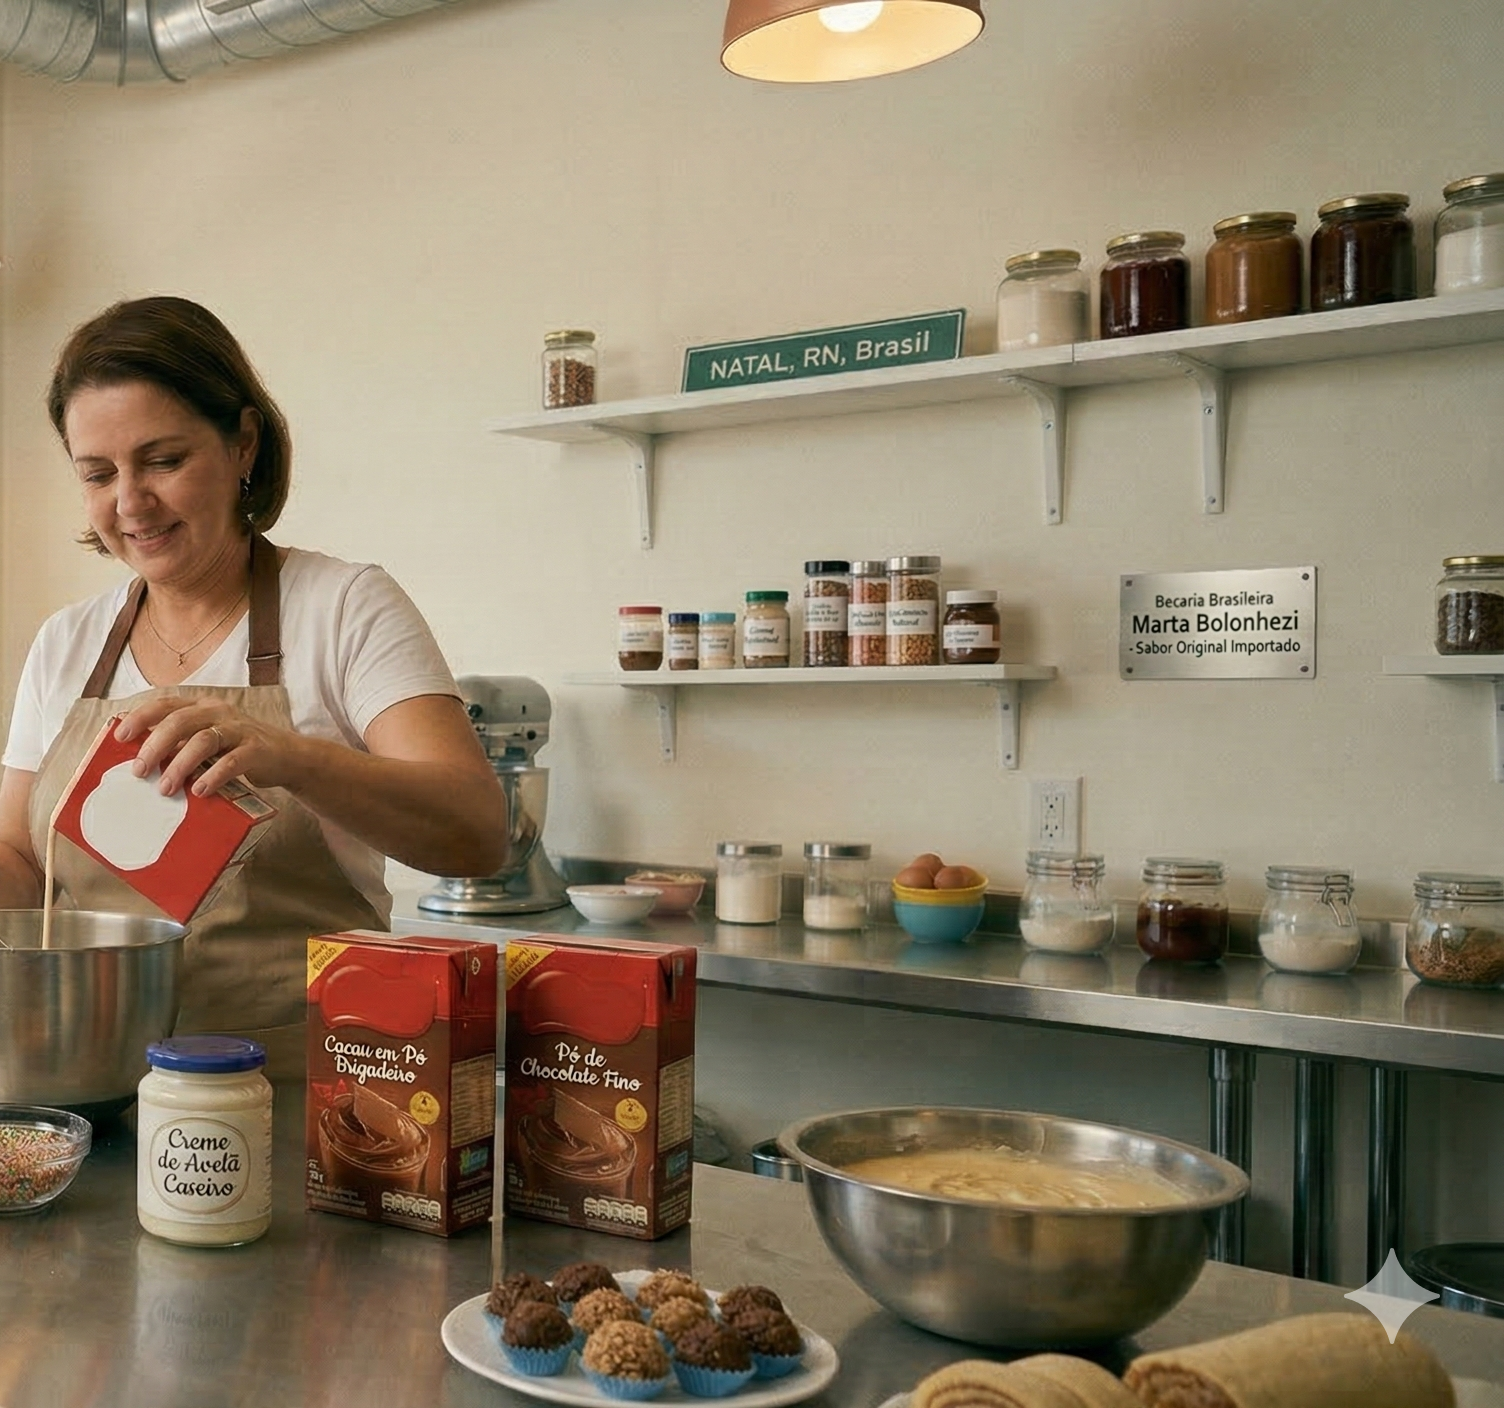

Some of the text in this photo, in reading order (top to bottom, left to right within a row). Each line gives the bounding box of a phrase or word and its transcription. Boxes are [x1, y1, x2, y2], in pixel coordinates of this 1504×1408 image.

[709, 330, 930, 381] NATAL, RN, Brasil
[1155, 591, 1274, 608] Becaria Brasileira
[1132, 610, 1299, 634] Marta Bolonhezi
[1136, 640, 1173, 655] Sabor
[1176, 639, 1227, 658] Original
[1231, 638, 1301, 656] Importado
[324, 1034, 428, 1066] Cacau em Pó
[554, 1041, 607, 1068] Pó de
[334, 1054, 417, 1085] Brigadeiro
[520, 1057, 643, 1091] Chocolate Fino
[168, 1128, 230, 1151] Creme
[158, 1149, 181, 1171] de
[163, 1173, 236, 1197] Caseiro
